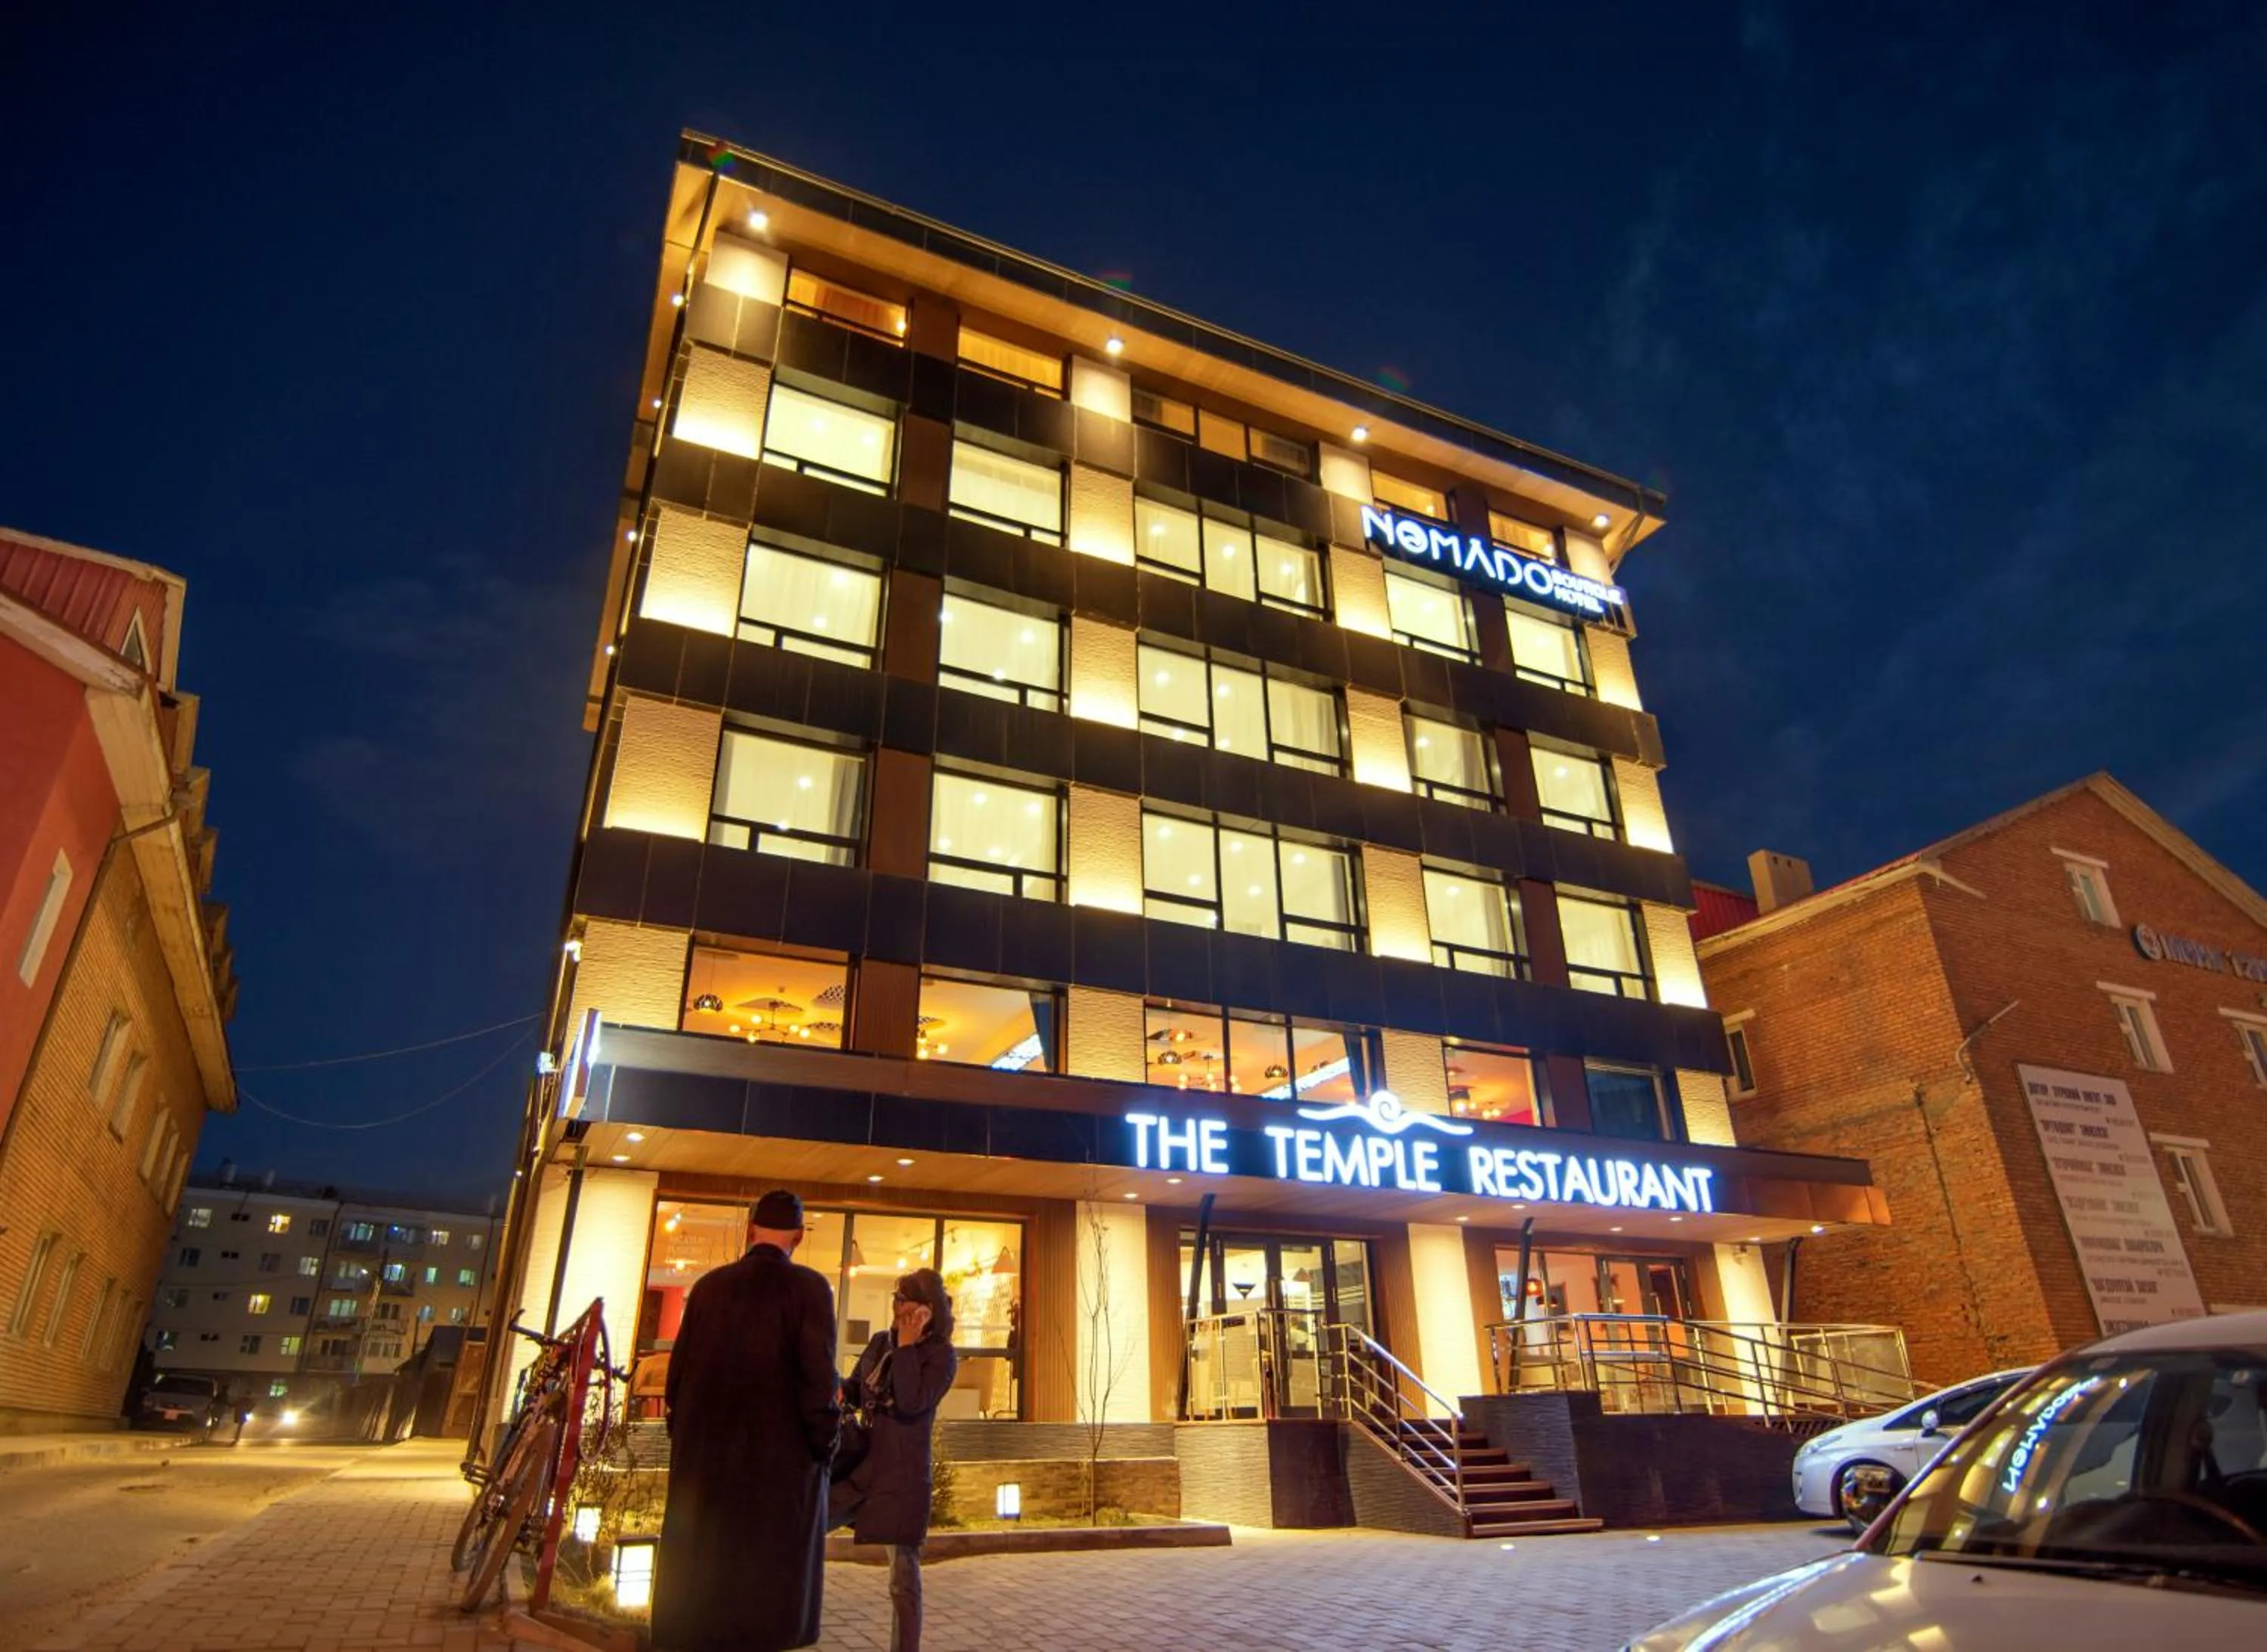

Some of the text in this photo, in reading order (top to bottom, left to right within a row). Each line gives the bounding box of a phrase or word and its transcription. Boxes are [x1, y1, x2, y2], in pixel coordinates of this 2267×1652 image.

[1360, 505, 1554, 594] NOMADO
[1554, 586, 1604, 613] HOTEL
[1125, 1114, 1713, 1213] THE TEMPLE RESTAURANT
